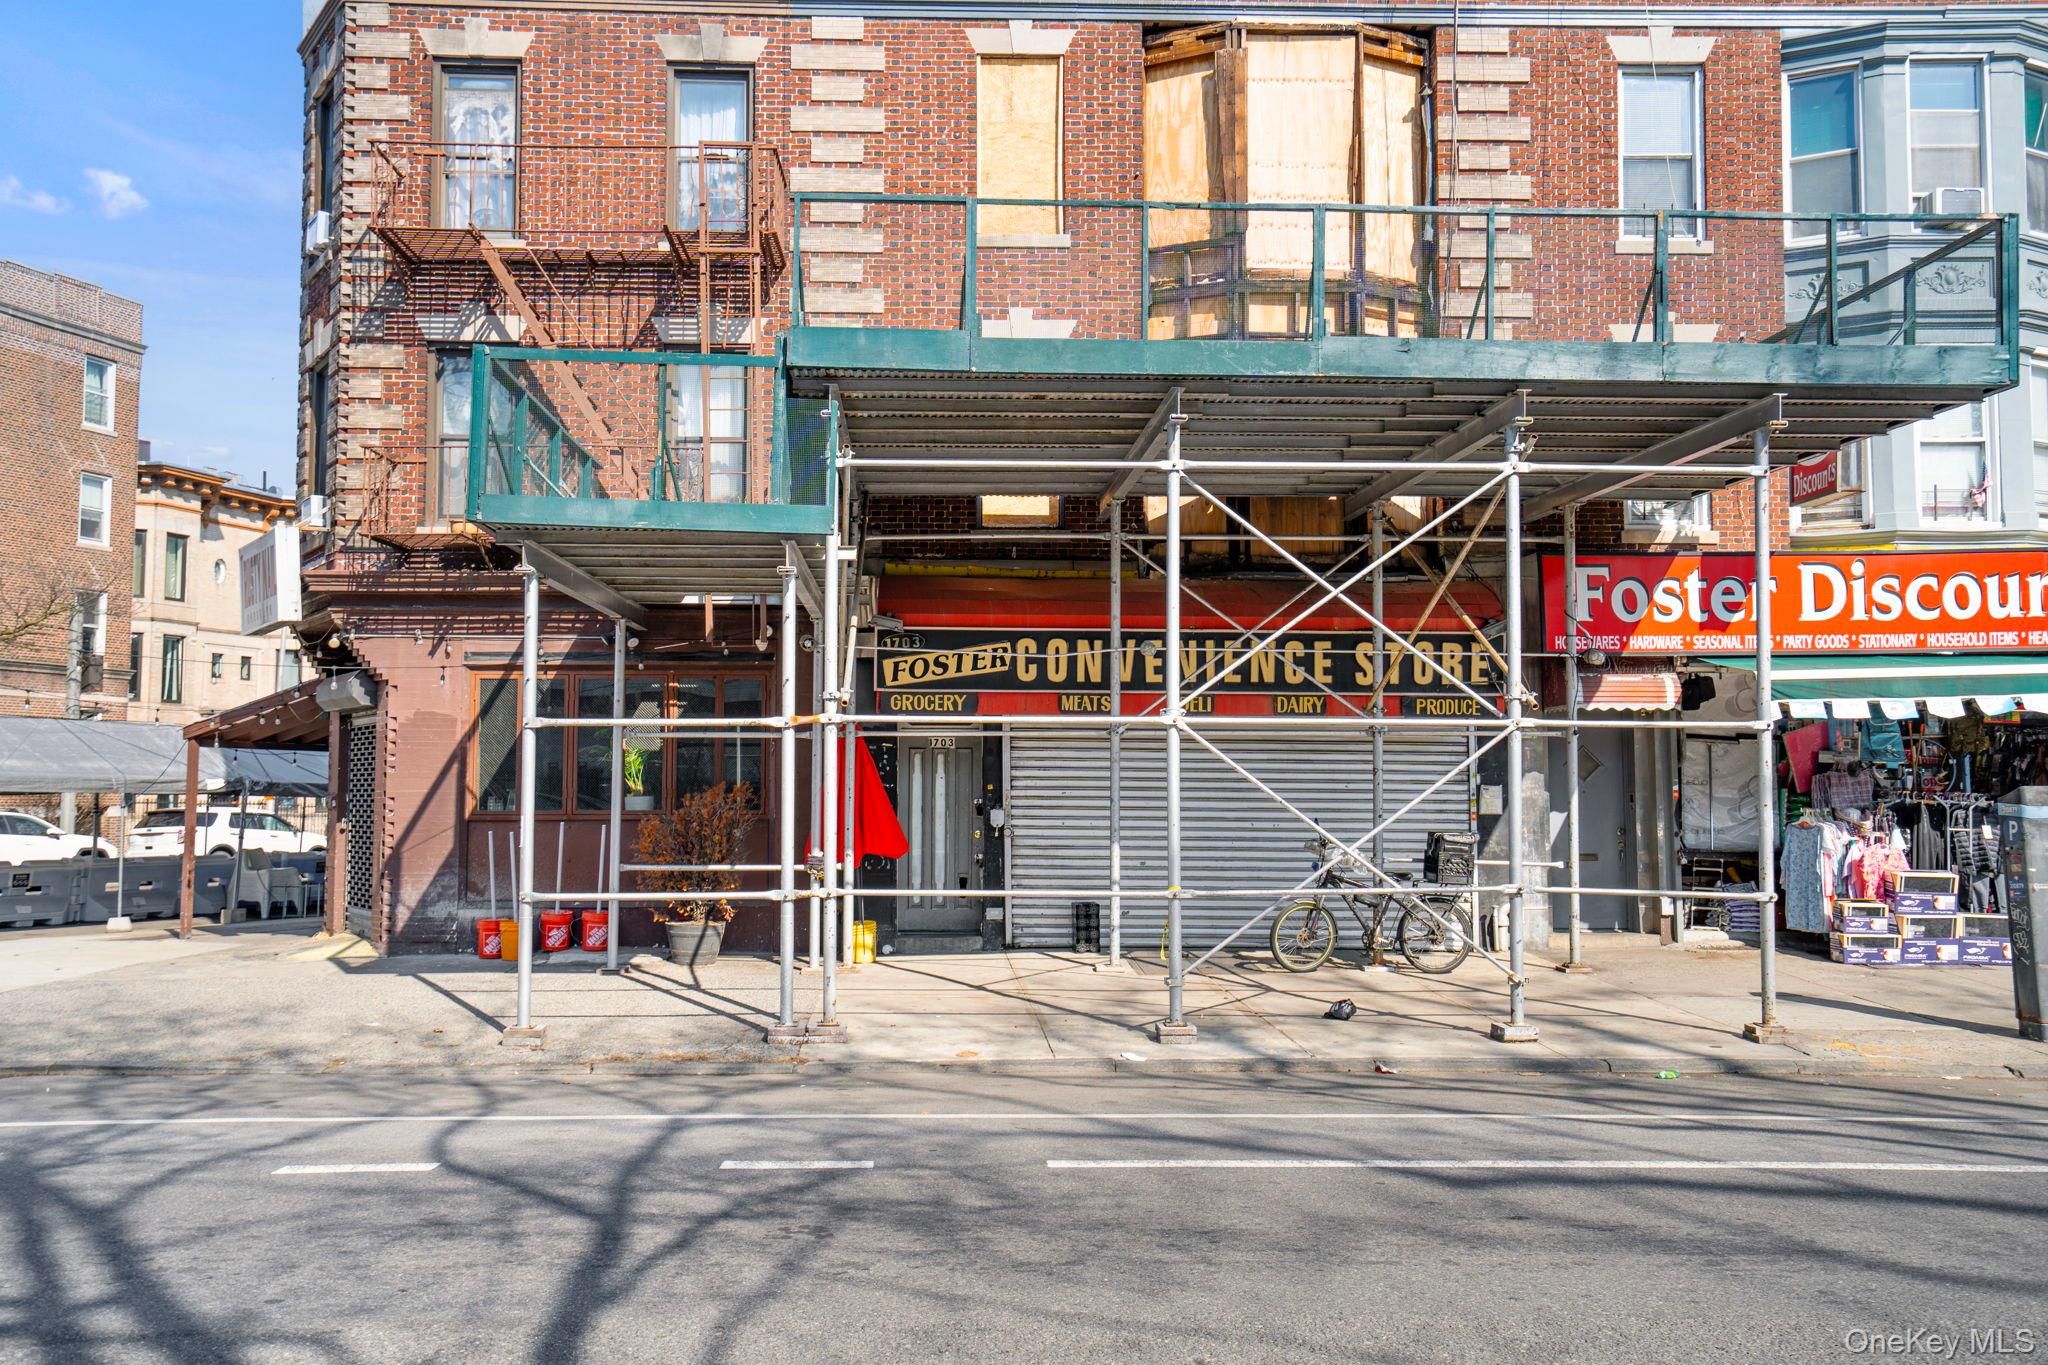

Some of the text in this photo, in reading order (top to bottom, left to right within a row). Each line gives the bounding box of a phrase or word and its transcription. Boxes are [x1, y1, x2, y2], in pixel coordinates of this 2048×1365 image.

[1793, 462, 1837, 498] Discounts
[884, 636, 921, 649] 1703
[1629, 635, 1684, 650] HARDWARE
[1692, 634, 1744, 650] SEASONAL
[1783, 634, 1813, 649] PARTY
[1815, 634, 1850, 649] GOODS
[1858, 633, 1918, 648] STATIONARY
[1927, 631, 1987, 648] HOUSEHOLD
[1989, 631, 2019, 646] ITEMS
[890, 637, 1490, 686] FOSTER CONVENIENCE STORE
[890, 694, 967, 712] GROCERY
[1061, 694, 1112, 712] MEATS
[1277, 696, 1325, 714] DAIRY
[1416, 698, 1481, 716] PRODUCE
[929, 738, 954, 747] 1703
[2008, 820, 2018, 841] P
